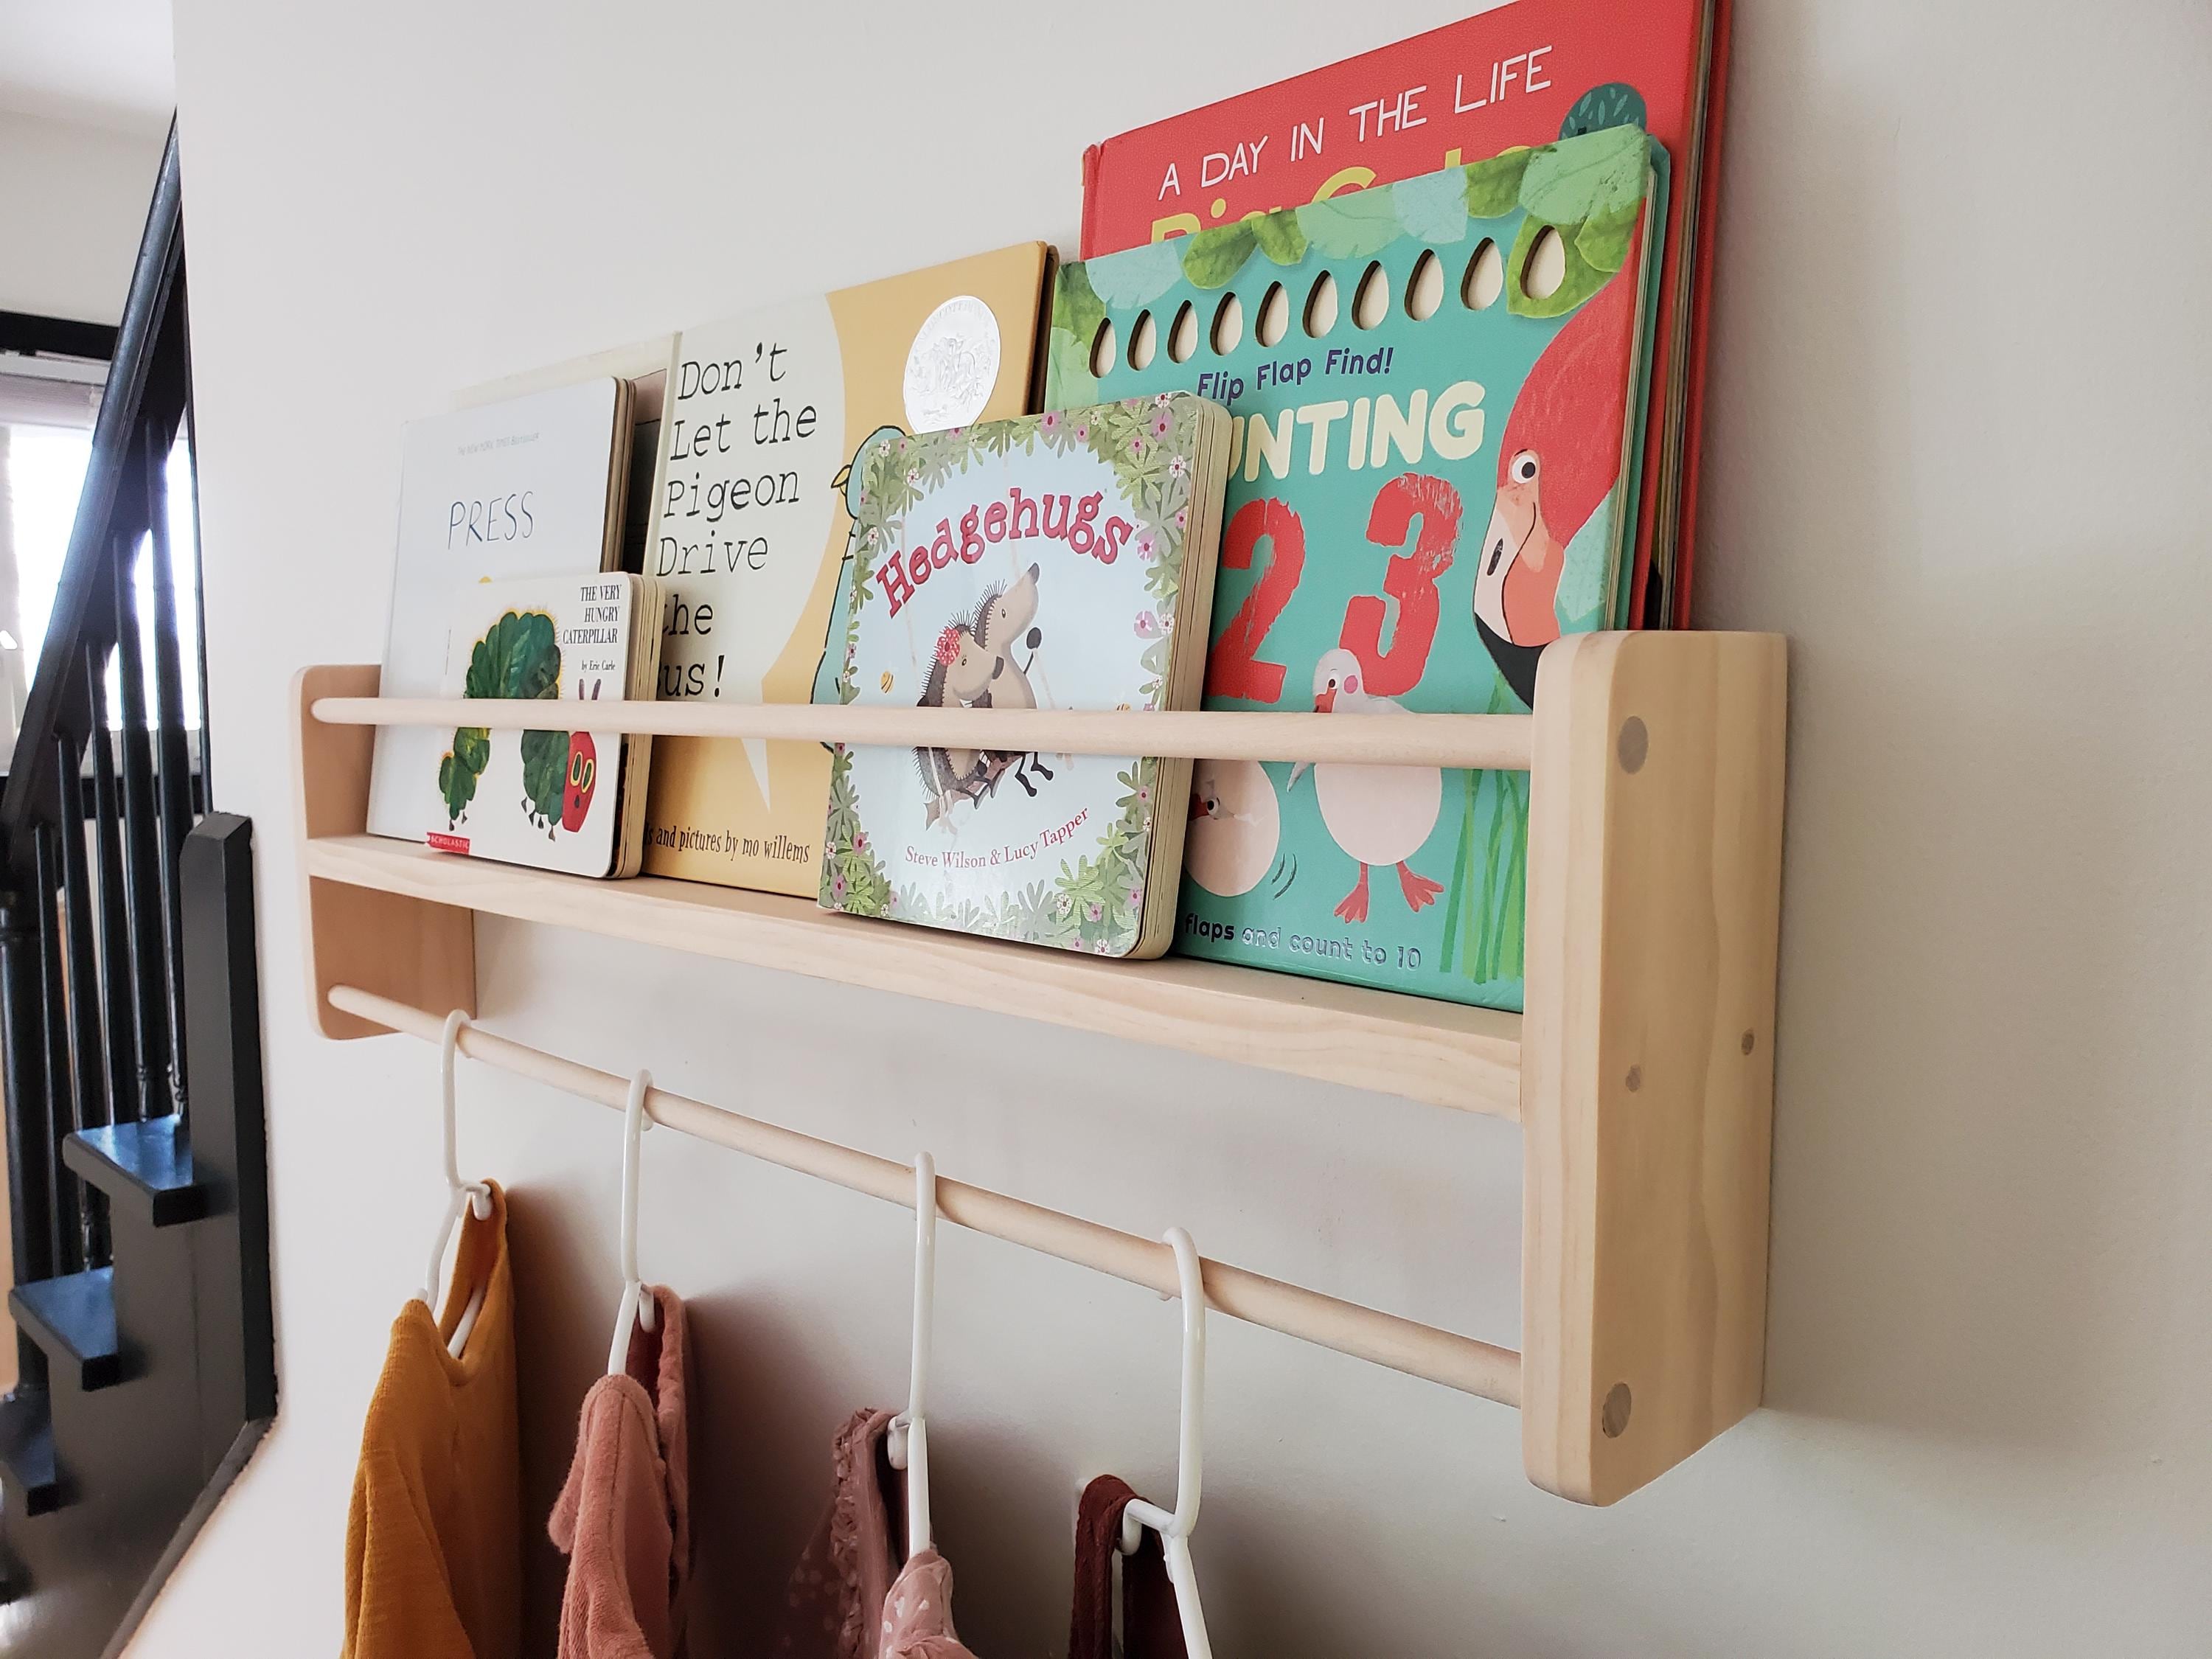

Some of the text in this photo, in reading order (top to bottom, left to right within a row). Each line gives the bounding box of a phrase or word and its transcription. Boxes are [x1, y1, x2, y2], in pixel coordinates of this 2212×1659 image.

[1158, 161, 1181, 201] A
[1200, 135, 1269, 189] DAY
[1290, 116, 1325, 162] IN
[1348, 84, 1427, 142] THE
[1454, 44, 1553, 115] LIFE
[677, 341, 787, 400] Don't
[1197, 347, 1394, 406] Flip Flap Find!
[669, 399, 817, 461] Let the
[448, 491, 534, 550] PRESS
[663, 469, 800, 523] Pigeon
[655, 529, 769, 577] Drive
[875, 487, 1133, 619] Hedgehugs
[580, 585, 622, 602] THE VERY
[584, 607, 619, 622] HUNGRY
[662, 593, 714, 636] he
[1202, 472, 1464, 704] 2 3
[563, 628, 618, 644] CATERPILLAR
[582, 660, 616, 672] by Eric Carle
[655, 654, 726, 700] us!
[656, 825, 677, 848] and
[678, 826, 723, 853] pictures
[725, 830, 739, 861] by
[742, 838, 759, 857] mo
[764, 834, 810, 863] willems
[905, 807, 1088, 869] Steve Wilson & Lucy Tapper
[1185, 913, 1422, 970] flaps and count to 10
